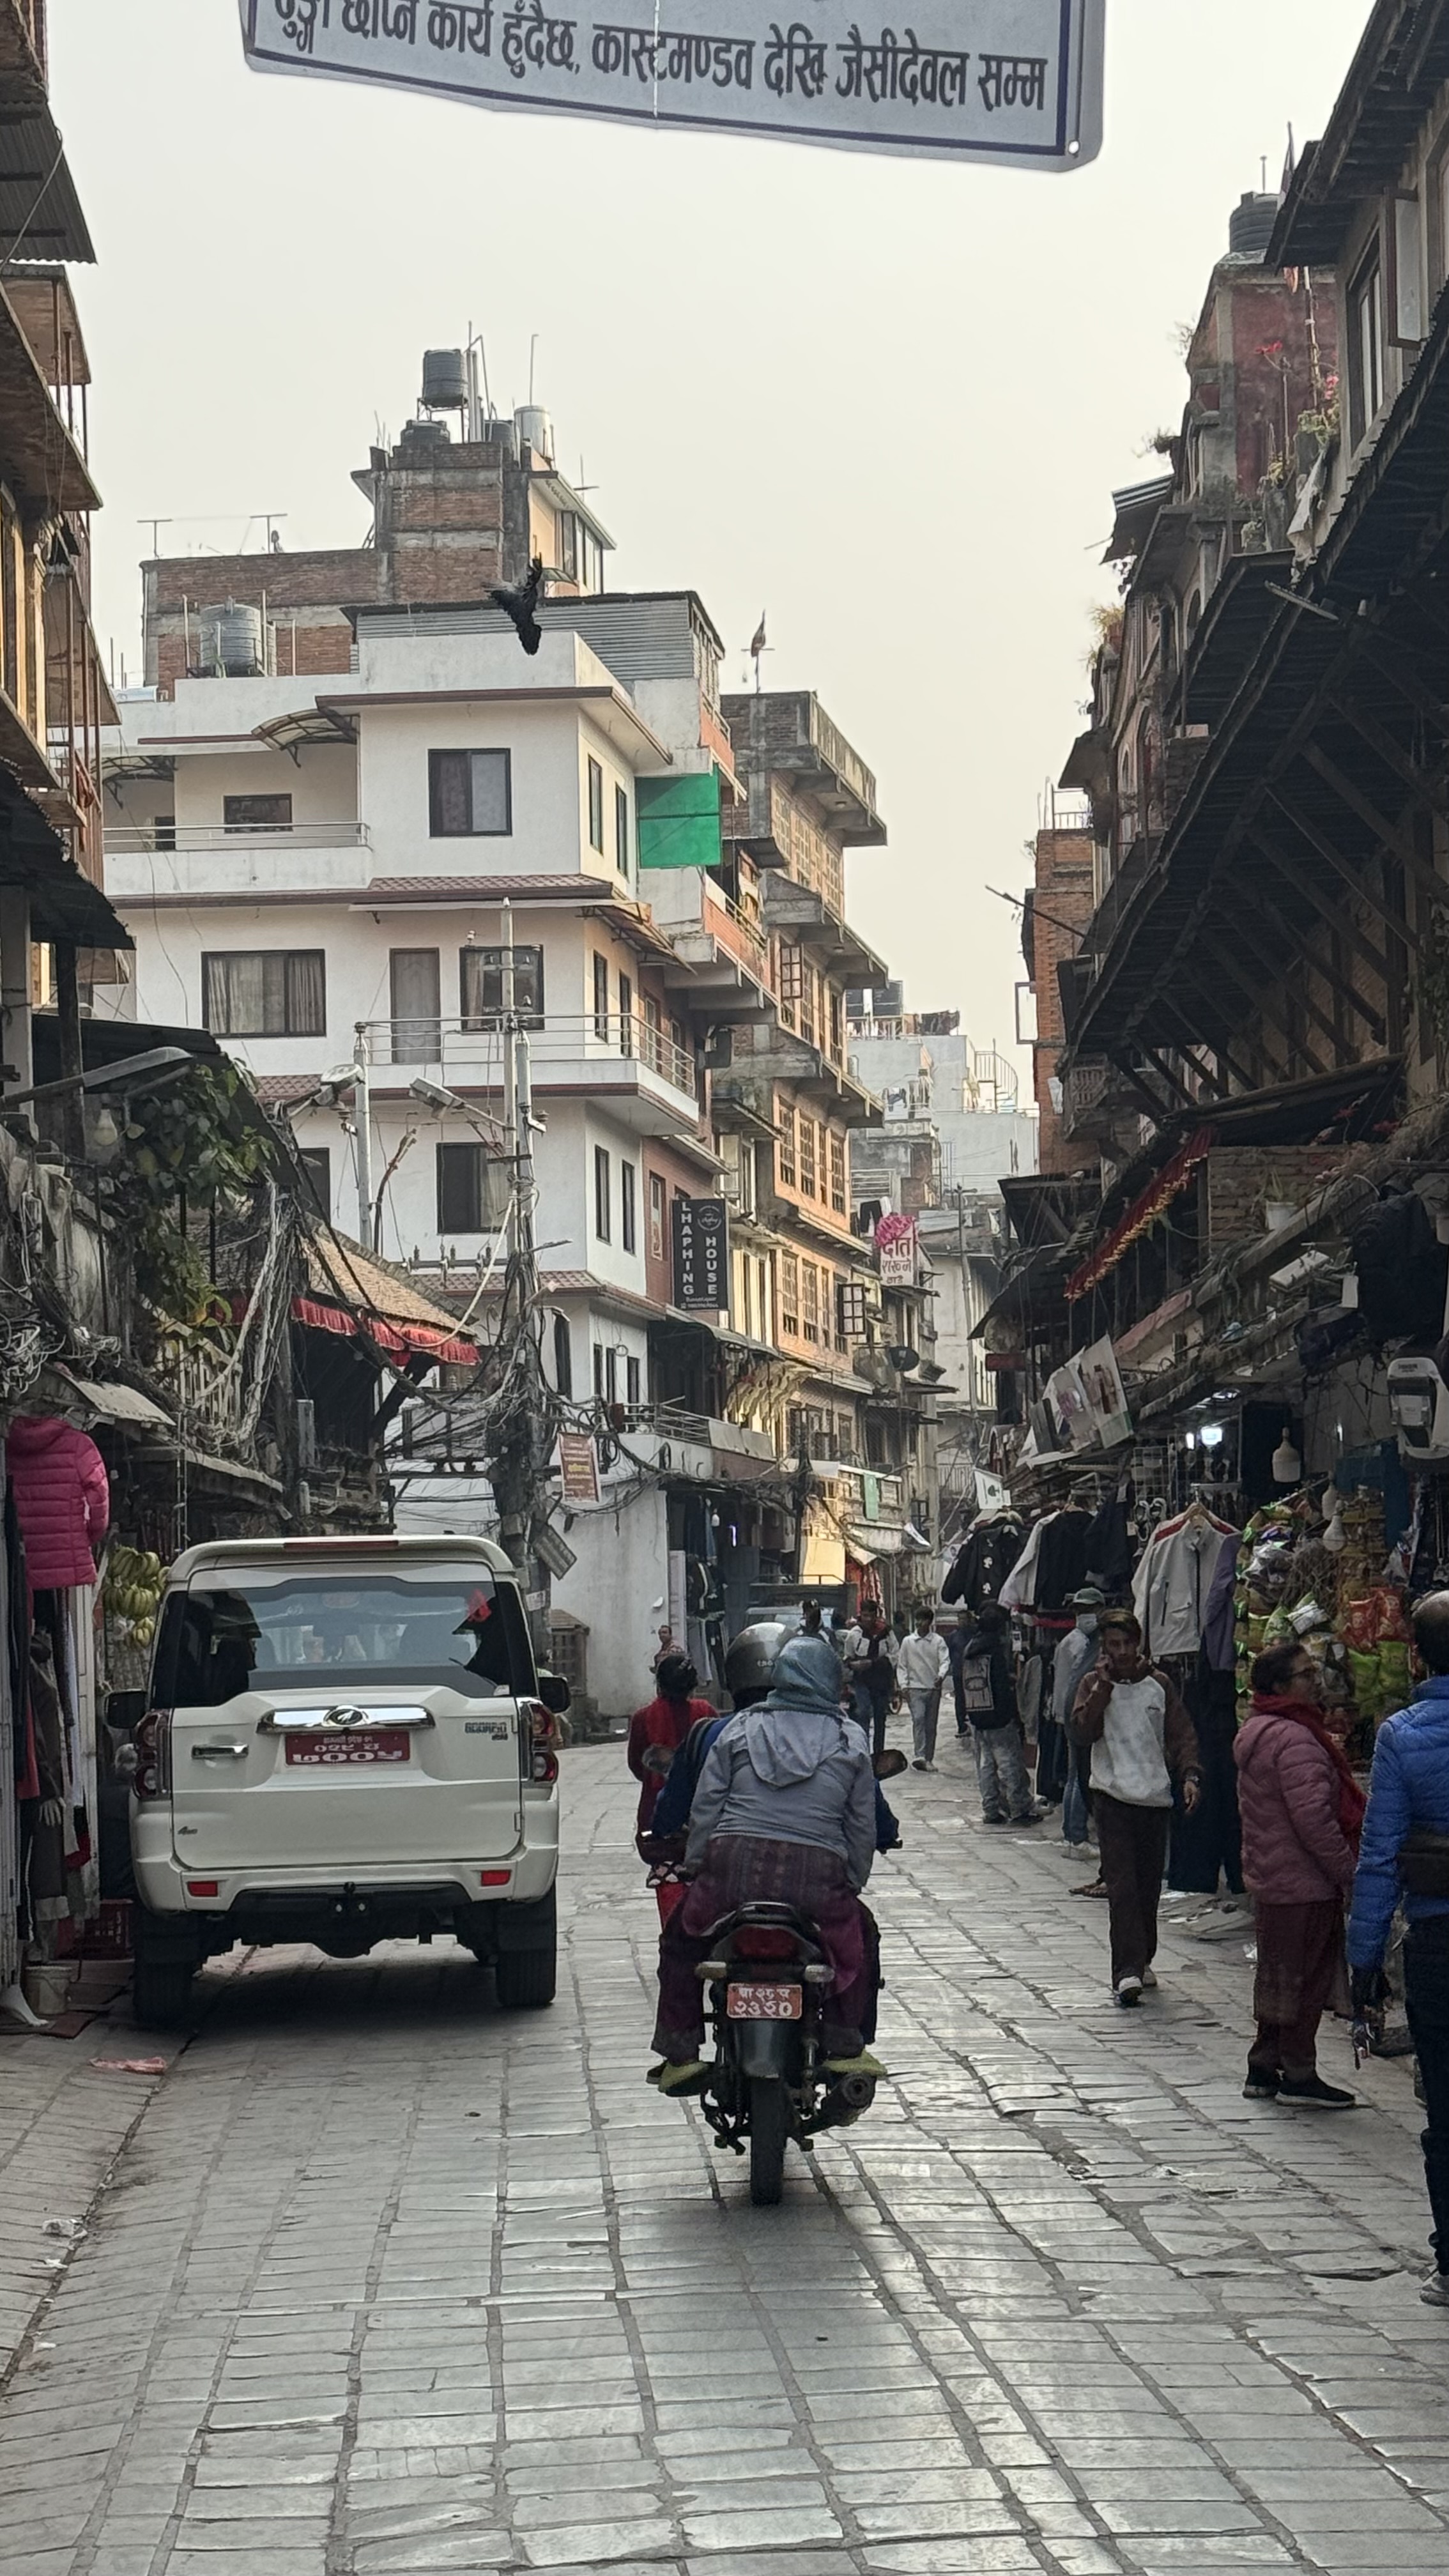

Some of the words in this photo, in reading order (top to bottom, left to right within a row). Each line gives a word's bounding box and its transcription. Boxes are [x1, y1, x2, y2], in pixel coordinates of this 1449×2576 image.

[764, 22, 828, 98] देखि
[835, 24, 970, 107] जैसीदेवल
[977, 53, 1048, 112] सम्म
[681, 1202, 694, 1295] LHAPHING
[705, 1236, 717, 1294] HOUSE
